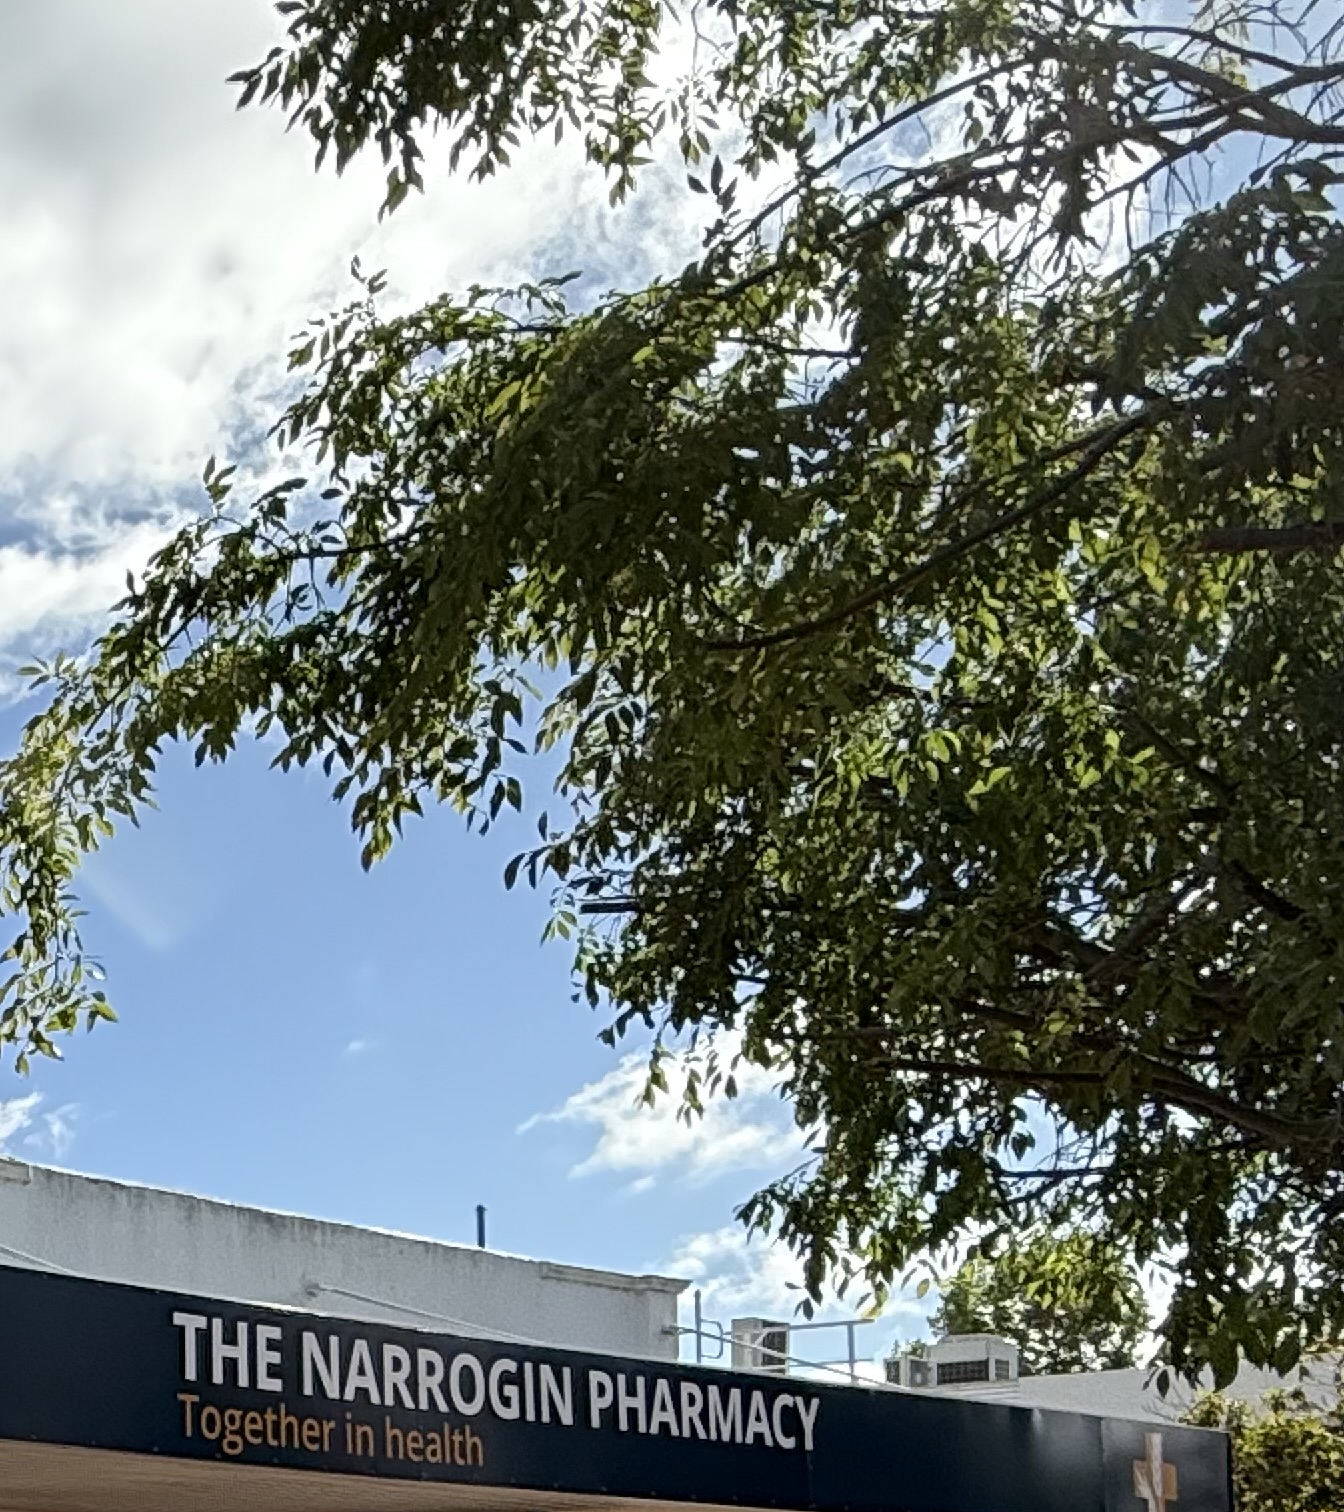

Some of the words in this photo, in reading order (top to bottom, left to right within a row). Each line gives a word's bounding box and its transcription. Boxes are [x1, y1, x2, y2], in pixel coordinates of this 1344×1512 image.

[172, 1311, 283, 1392] THE
[302, 1332, 573, 1426] NARROGIN
[588, 1370, 820, 1452] PHARMACY
[178, 1393, 335, 1455] Together
[346, 1413, 374, 1456] in
[384, 1419, 484, 1467] health
